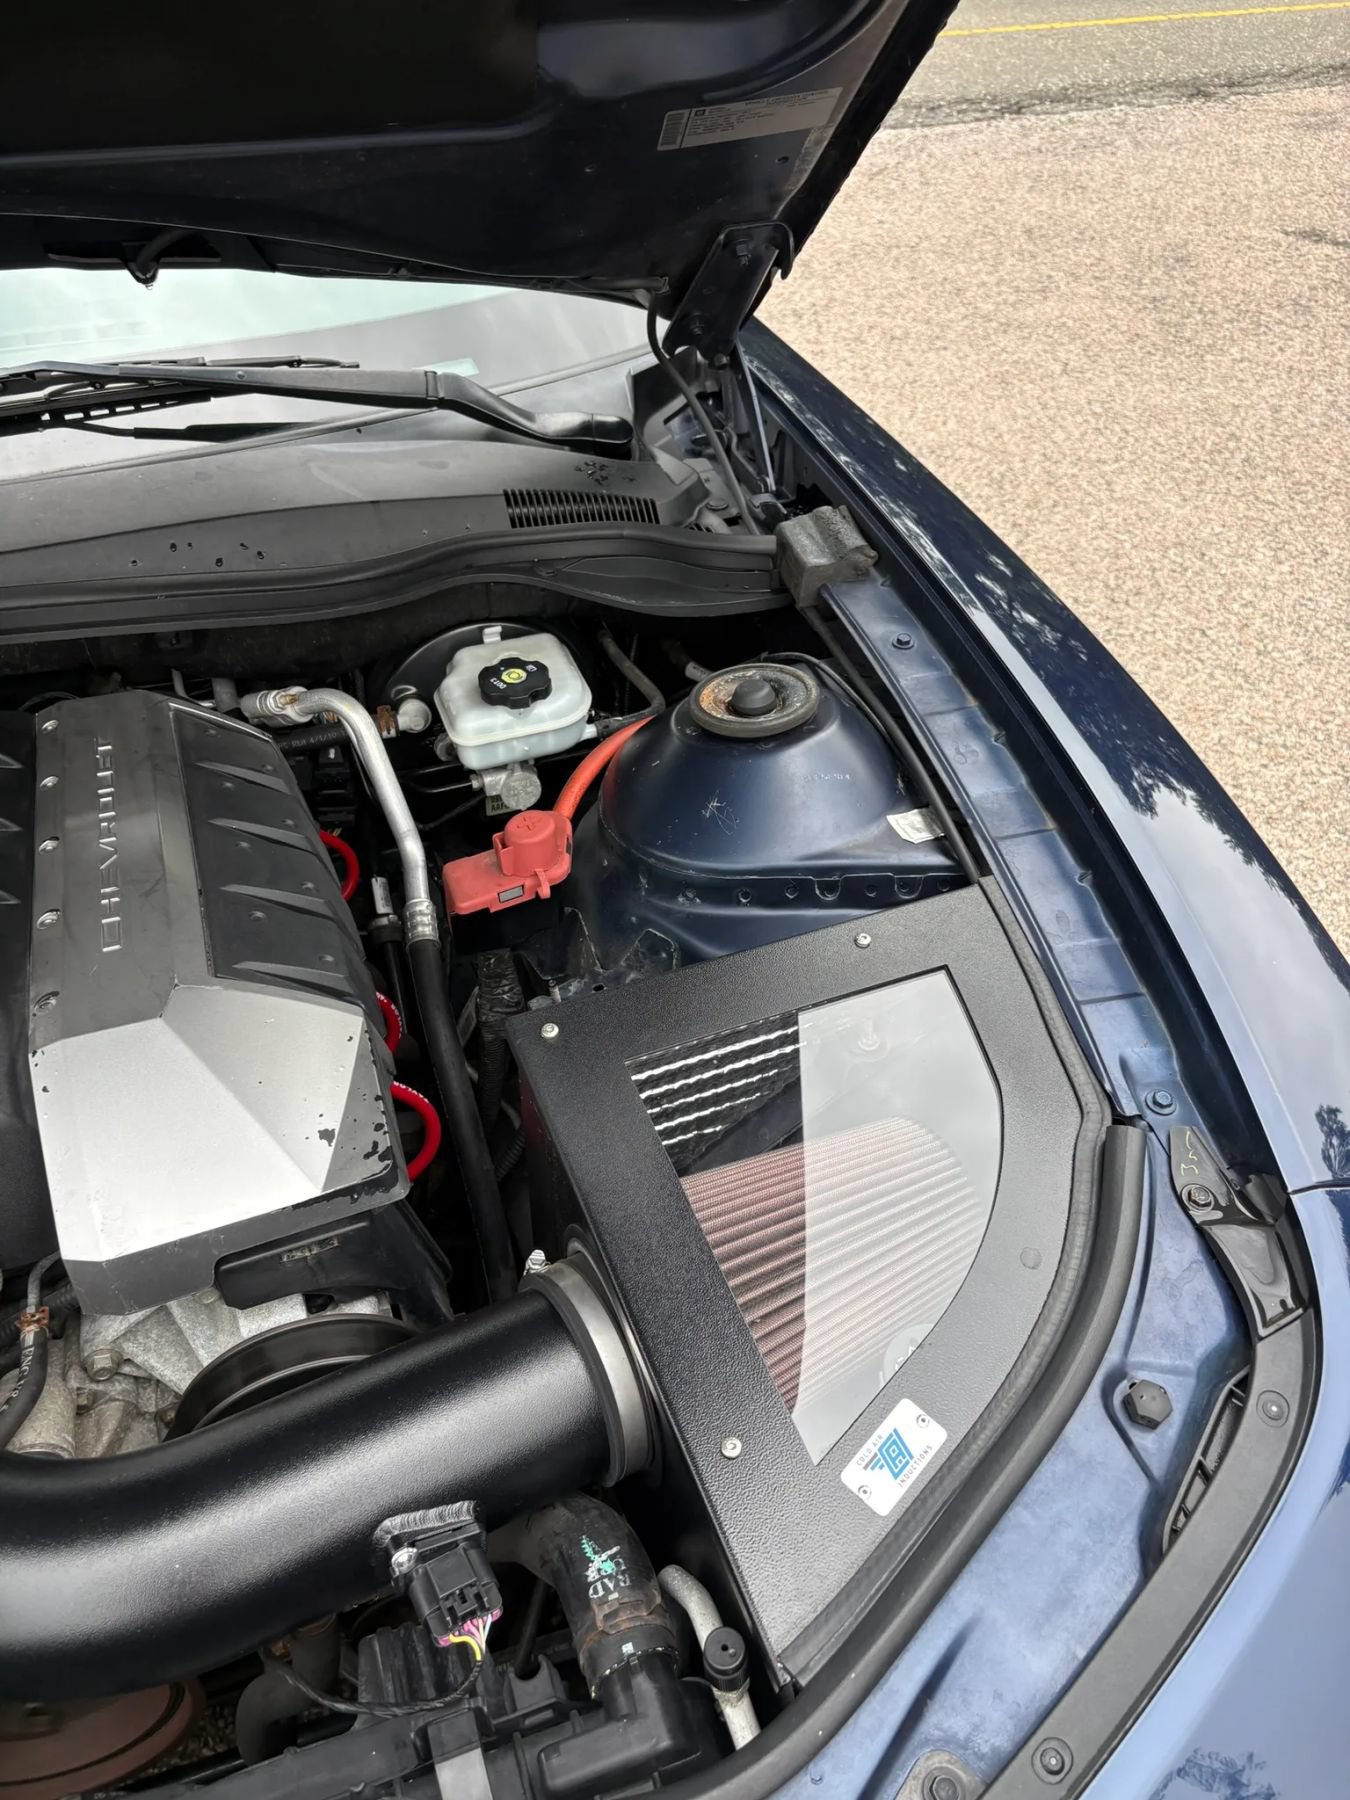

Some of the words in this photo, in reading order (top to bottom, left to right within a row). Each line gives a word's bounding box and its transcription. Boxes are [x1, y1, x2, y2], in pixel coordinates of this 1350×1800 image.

[95, 736, 123, 953] CHEVROLET
[856, 1447, 873, 1467] COLD
[871, 1434, 884, 1448] AIR
[897, 1444, 934, 1488] INDUCTIONS
